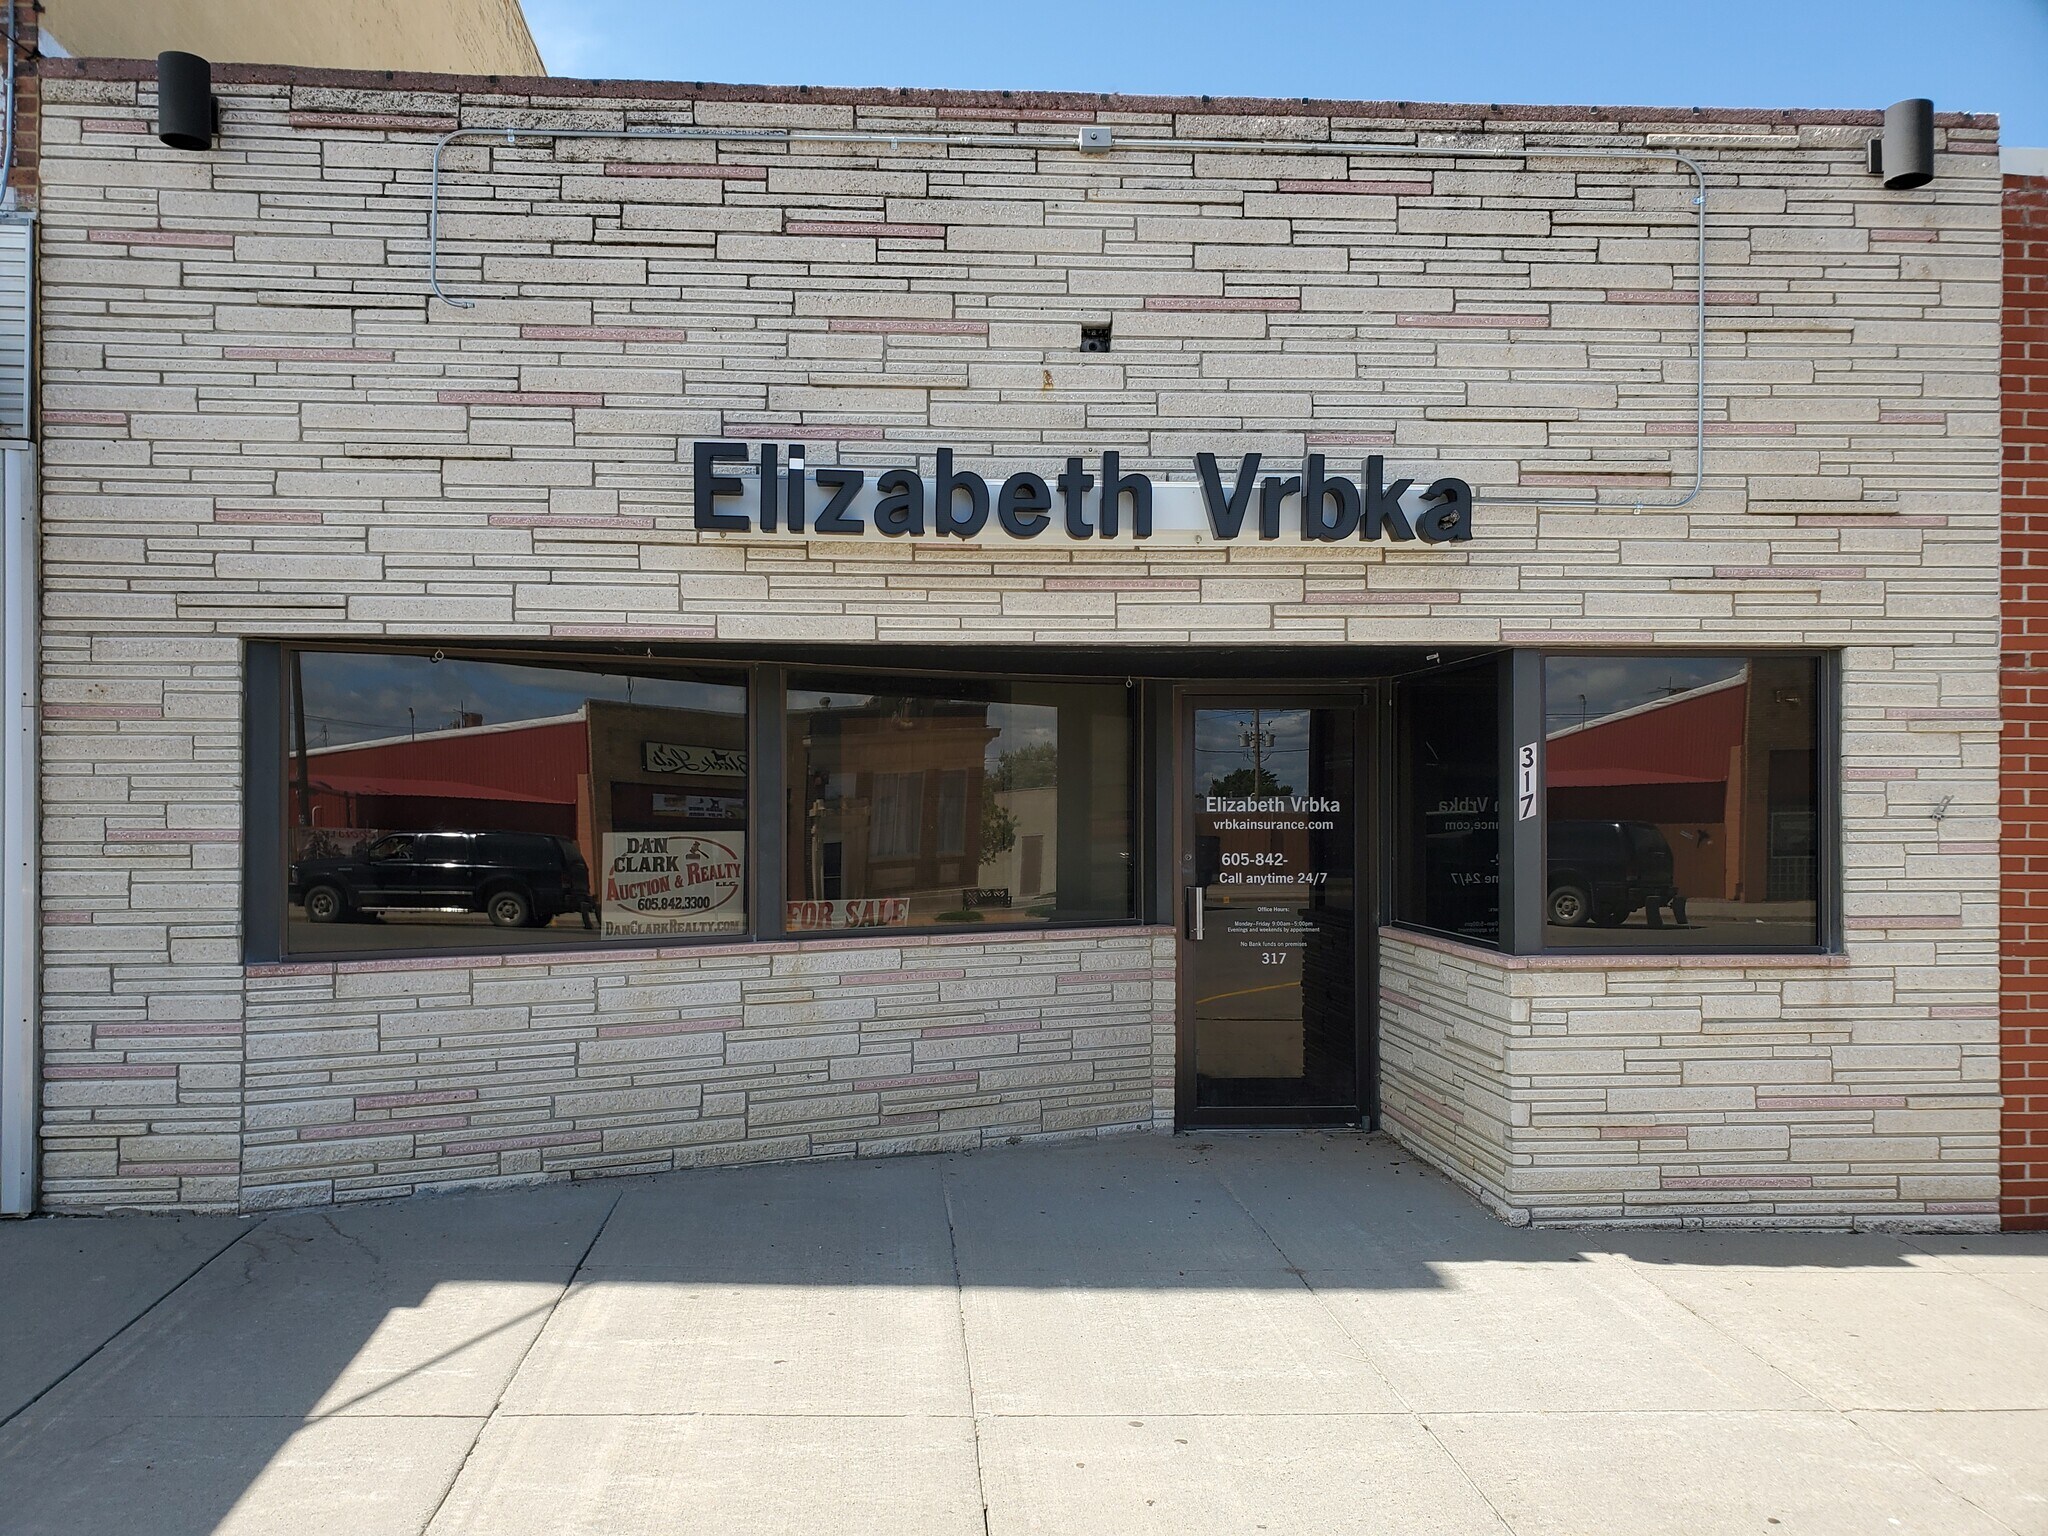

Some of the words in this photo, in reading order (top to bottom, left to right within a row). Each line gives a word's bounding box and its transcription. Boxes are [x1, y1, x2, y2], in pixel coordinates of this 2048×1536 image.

[694, 442, 1153, 538] Elizabeth
[1193, 452, 1473, 545] Vrbka
[1521, 746, 1535, 819] 317
[1206, 796, 1285, 813] Elizabeth
[1290, 796, 1341, 813] Vrbka
[1213, 818, 1334, 831] vrbkainsurance.com
[626, 837, 669, 854] DAN
[613, 854, 680, 873] CLARK
[1221, 852, 1289, 867] 605-842-
[606, 874, 671, 902] AUCTION
[674, 874, 685, 889] &
[686, 861, 741, 887] REALTY
[1219, 872, 1242, 884] Call
[1245, 872, 1294, 886] anytime
[1297, 872, 1328, 886] 24/7
[637, 896, 711, 911] 605.842.3300
[785, 901, 834, 929] FOR
[844, 899, 908, 928] SALE
[1261, 952, 1287, 965] 317
